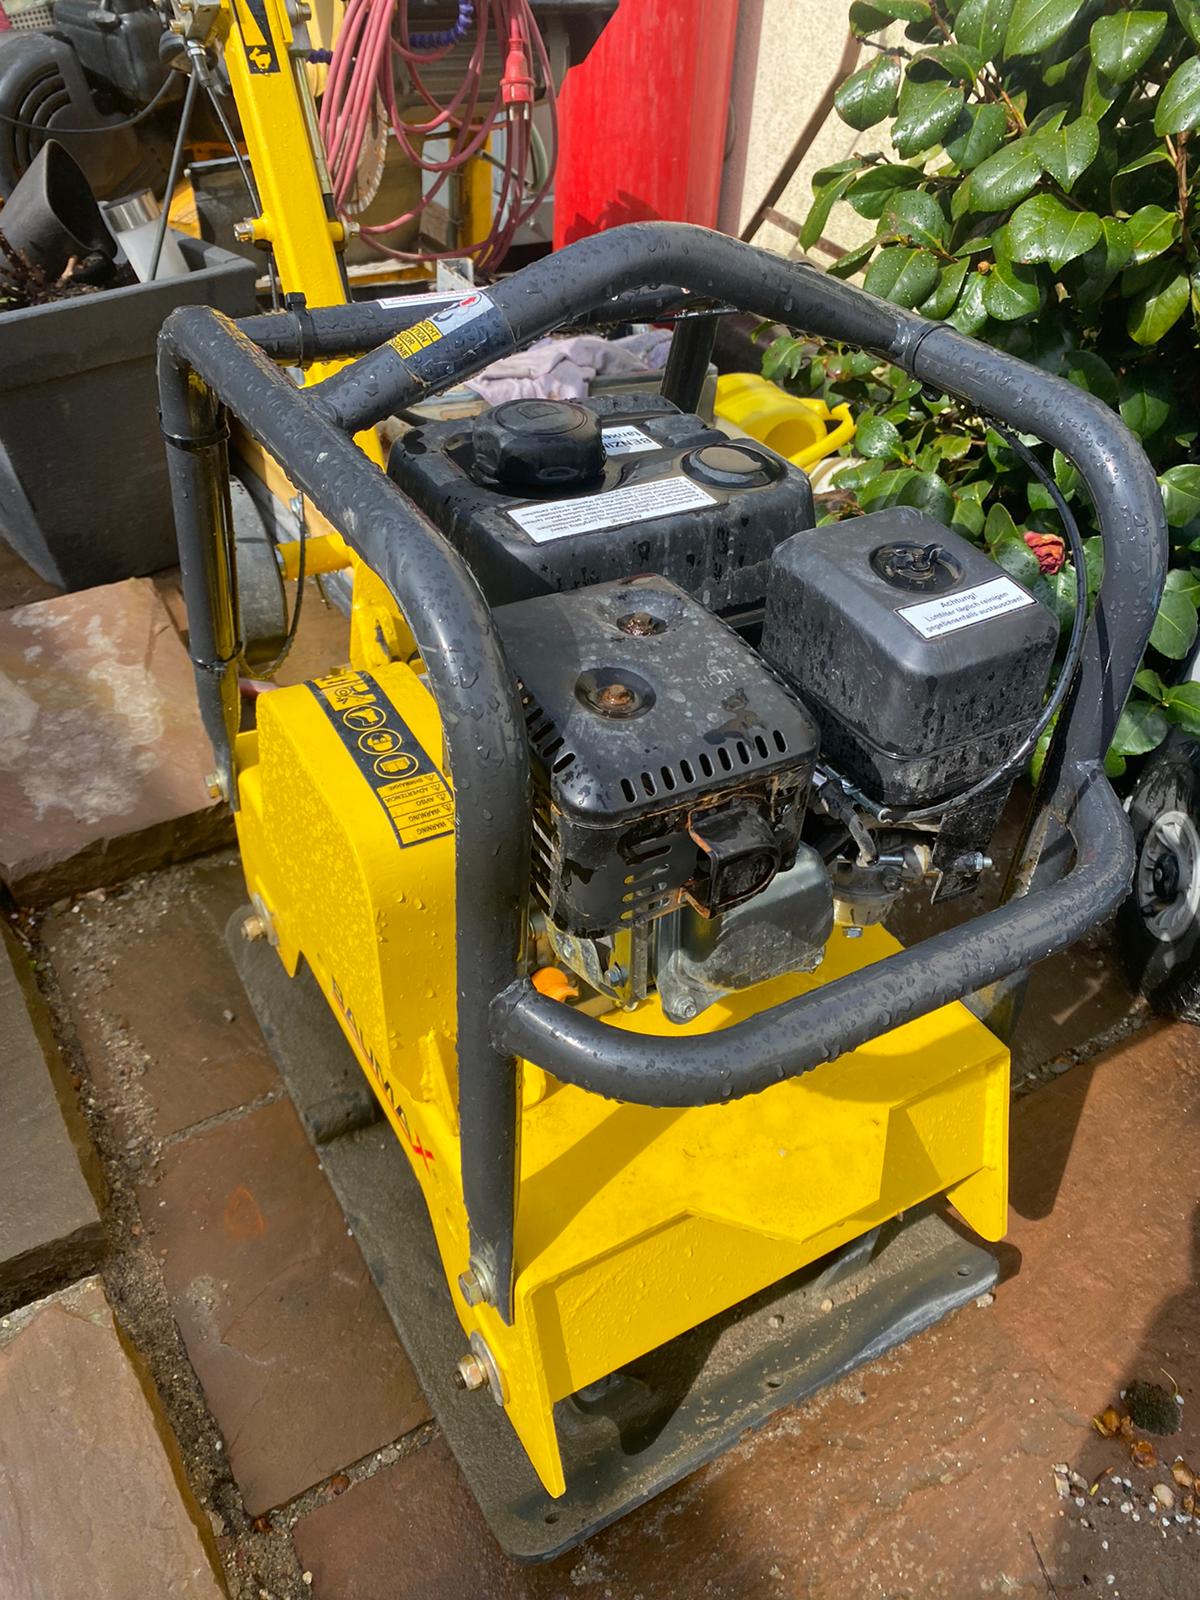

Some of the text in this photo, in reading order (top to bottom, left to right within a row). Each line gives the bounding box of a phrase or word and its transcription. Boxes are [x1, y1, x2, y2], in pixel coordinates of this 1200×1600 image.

[940, 592, 978, 608] Achtung!
[956, 601, 980, 615] täglich
[980, 591, 1009, 606] reinigen
[979, 595, 1025, 616] austauschen!
[386, 788, 429, 803] ADVERTENCIA
[415, 797, 435, 806] AVISO
[408, 808, 442, 822] WARNUNG
[416, 821, 447, 835] WARNING
